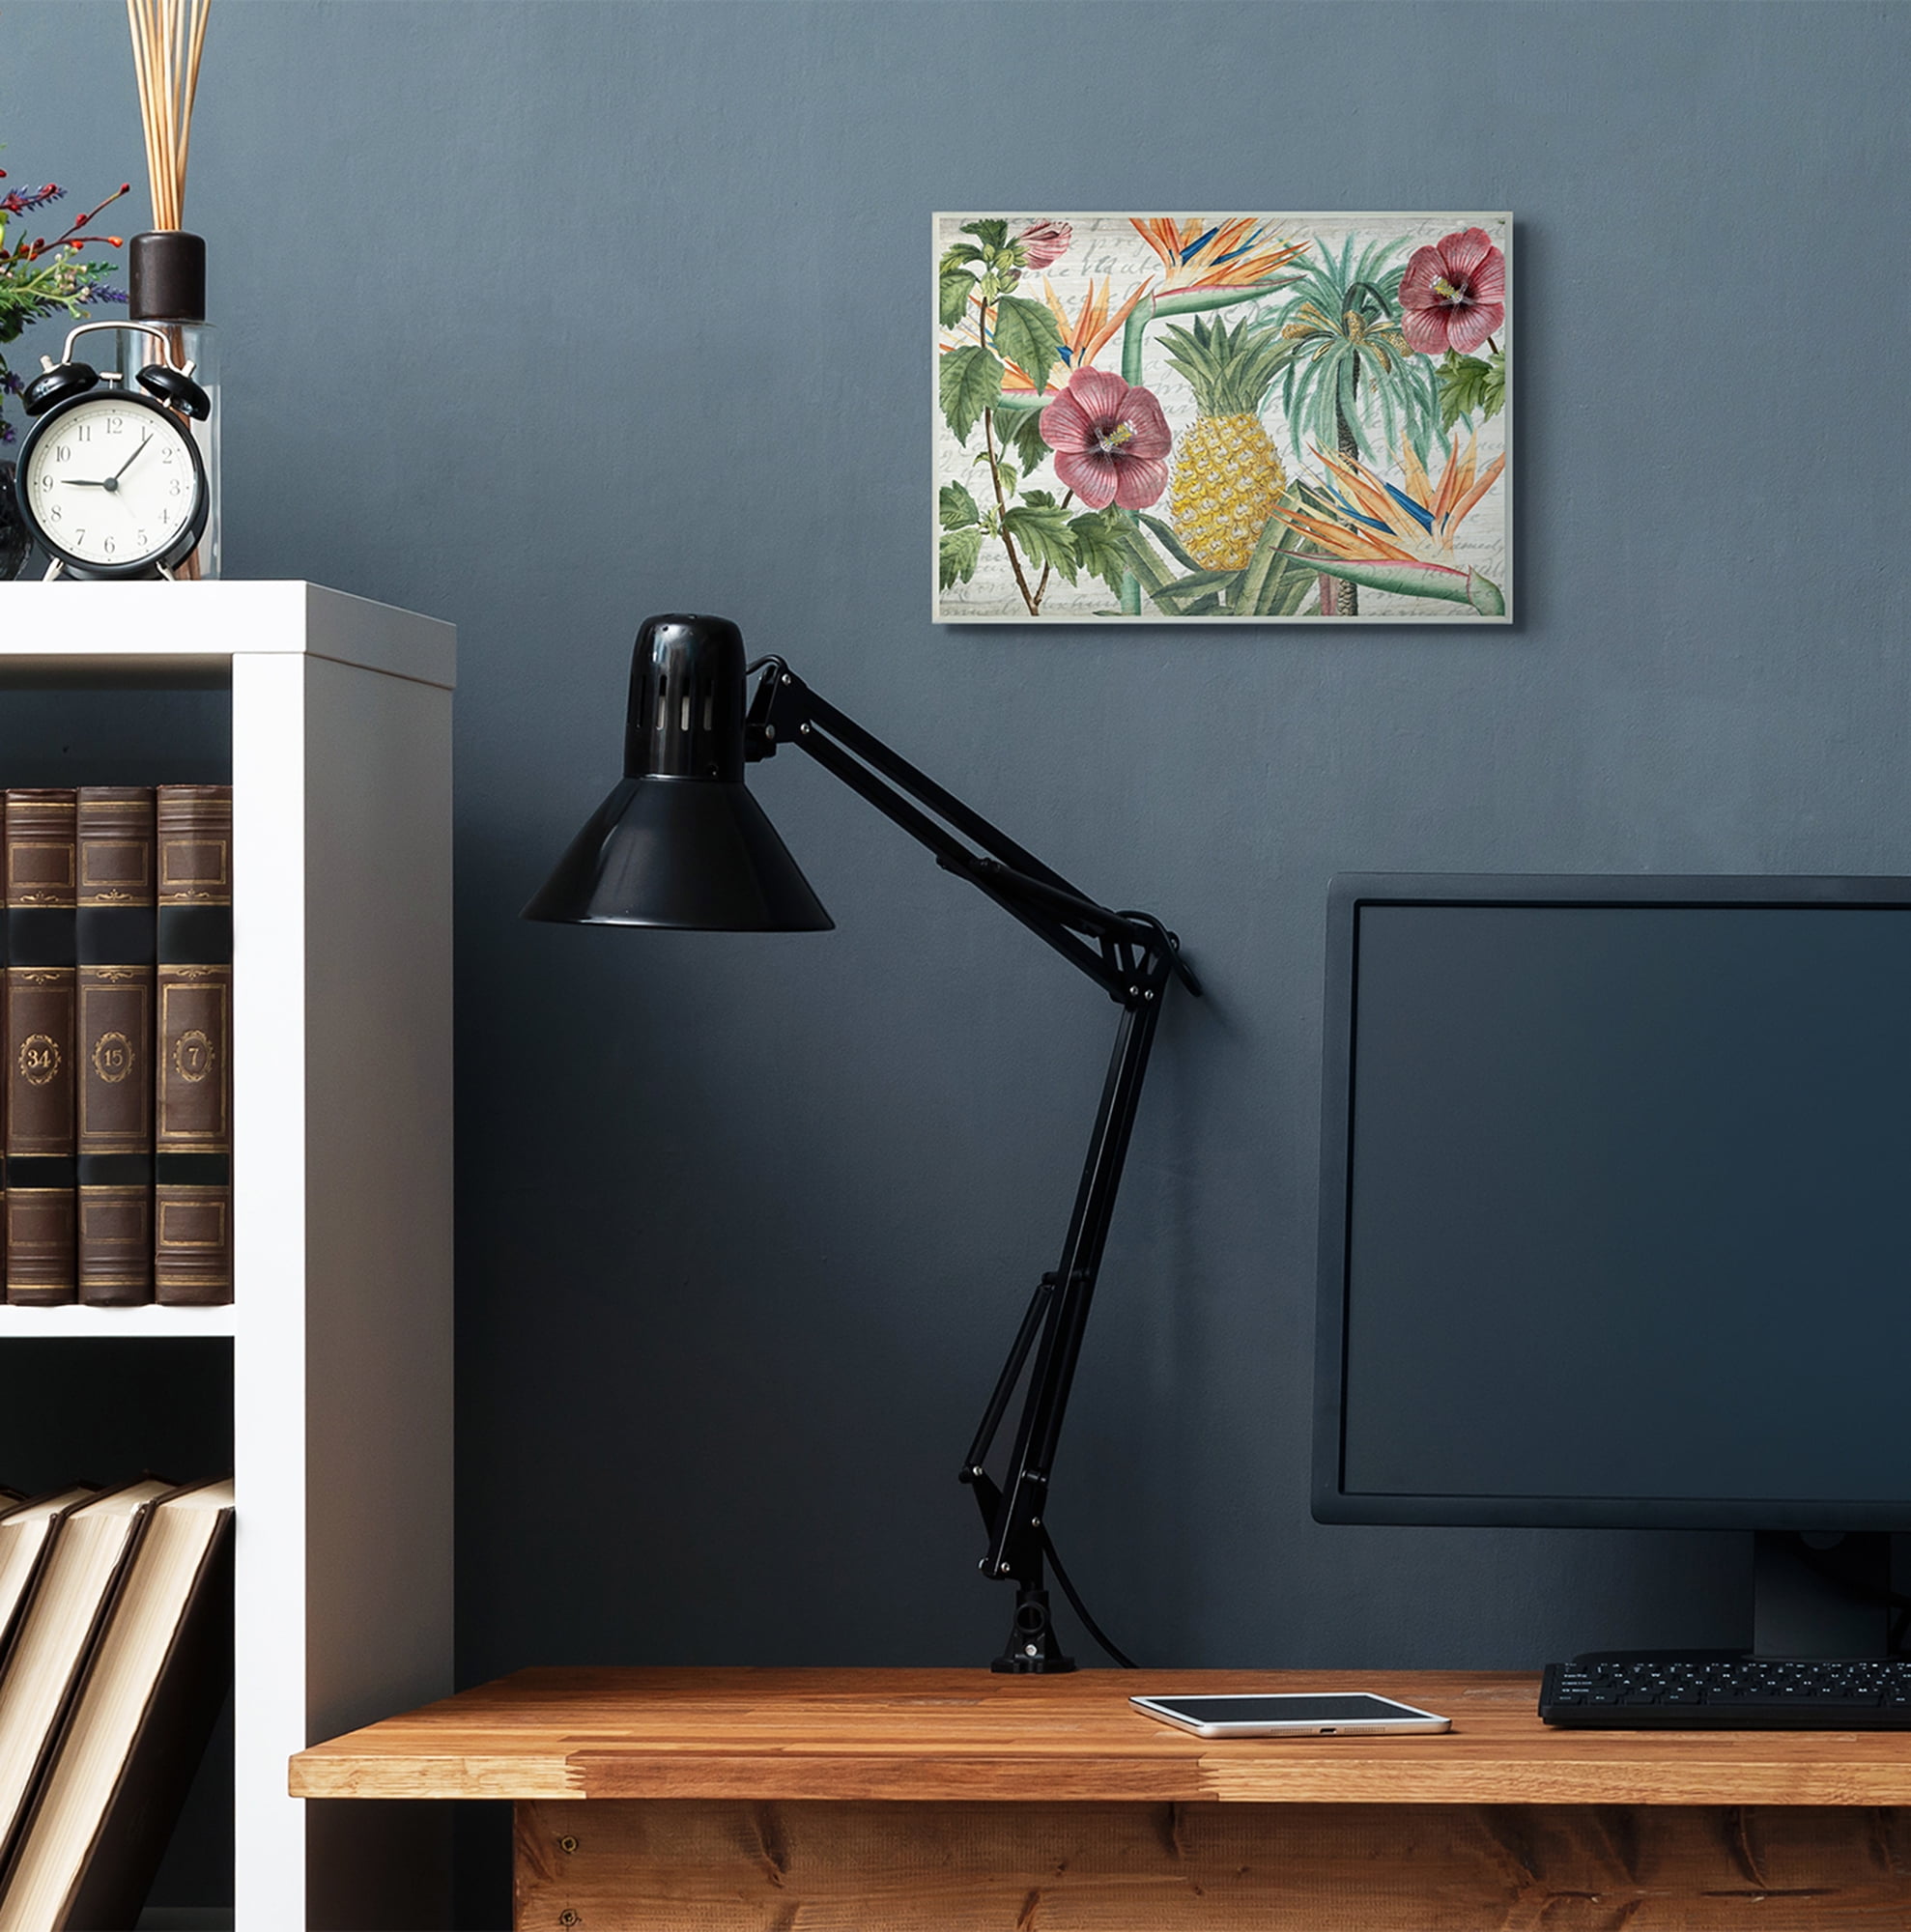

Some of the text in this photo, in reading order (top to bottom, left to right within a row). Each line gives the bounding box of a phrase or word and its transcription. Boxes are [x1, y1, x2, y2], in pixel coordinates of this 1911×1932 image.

[78, 426, 91, 441] 11
[106, 417, 123, 434] 12
[141, 426, 146, 441] 1
[56, 446, 71, 462] 10
[161, 447, 172, 464] 2
[43, 475, 53, 493] 9
[169, 479, 181, 497] 3
[50, 505, 62, 522] 8
[158, 508, 170, 524] 4
[74, 529, 85, 545] 7
[104, 536, 115, 554] 6
[137, 529, 148, 546] 5
[27, 1049, 51, 1067] 34
[104, 1049, 123, 1066] 15
[188, 1048, 199, 1066] 7
